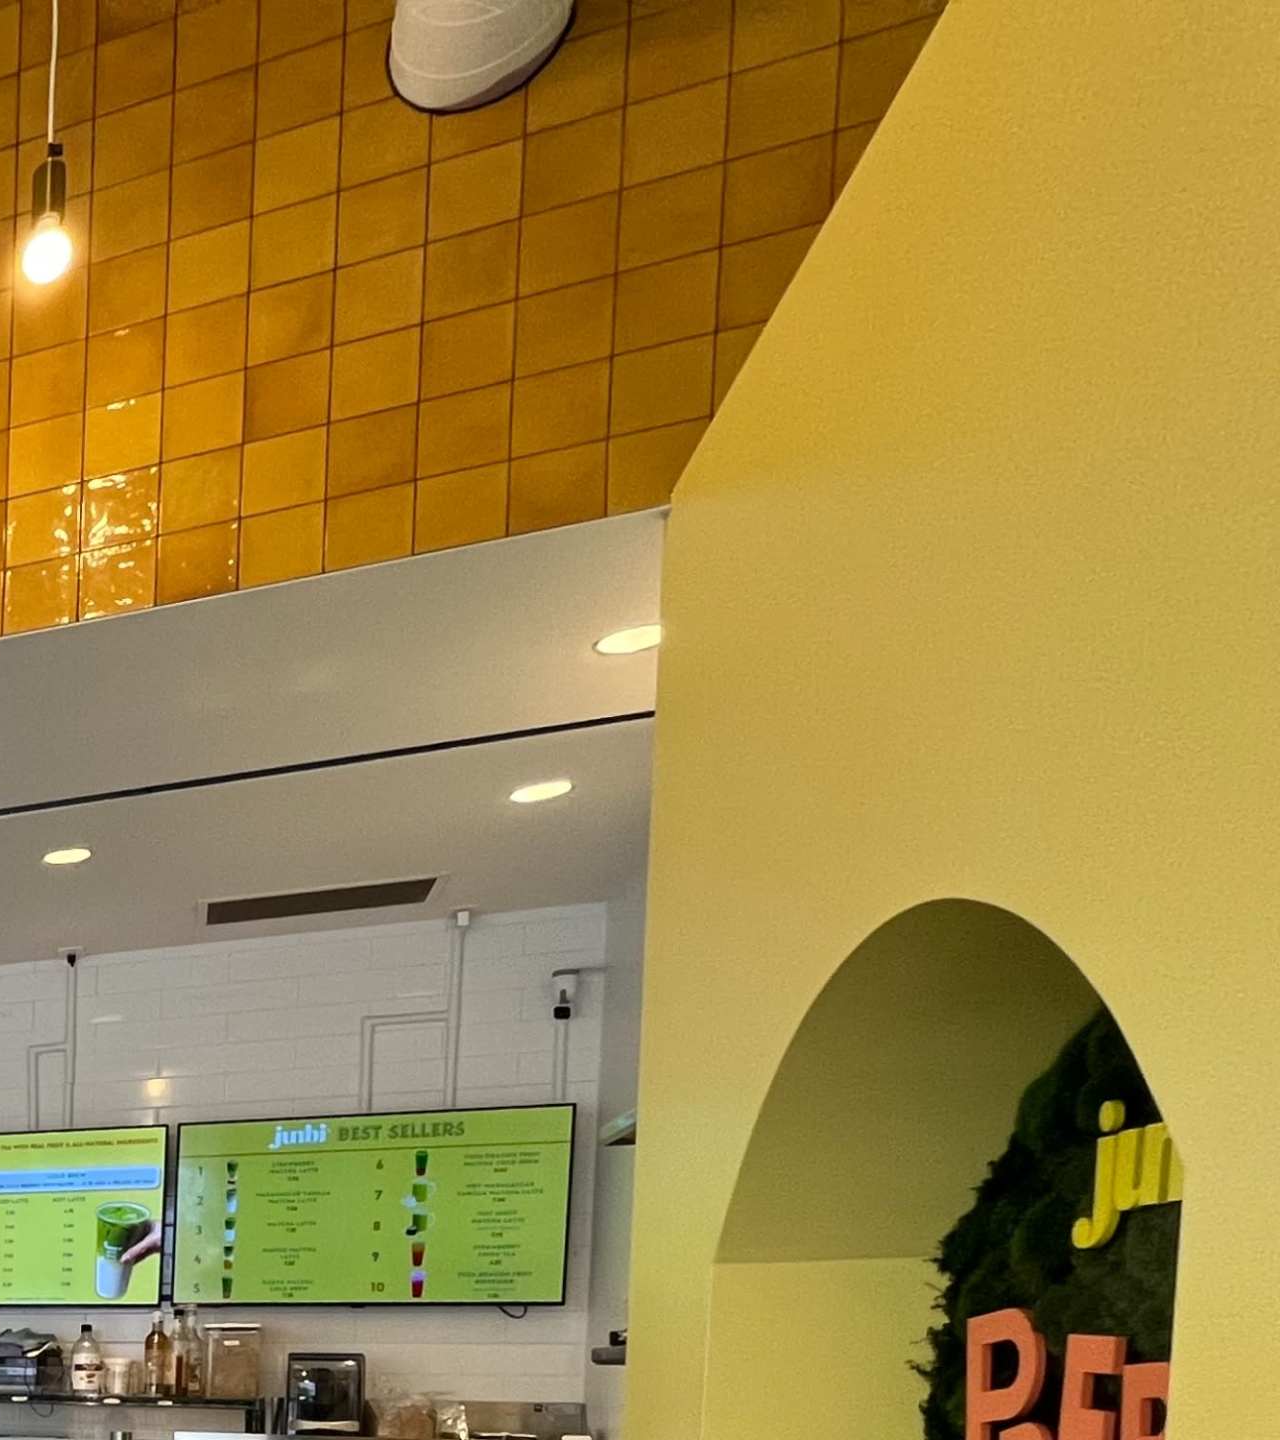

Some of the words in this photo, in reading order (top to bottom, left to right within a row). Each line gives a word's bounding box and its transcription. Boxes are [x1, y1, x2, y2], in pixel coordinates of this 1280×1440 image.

[267, 1123, 329, 1149] junbi
[338, 1124, 383, 1142] BEST
[387, 1121, 465, 1140] SELLERS
[375, 1159, 384, 1169] 6
[374, 1190, 383, 1200] 7
[373, 1221, 381, 1231] 8
[371, 1252, 380, 1262] 9
[193, 1283, 201, 1293] 5
[370, 1282, 385, 1293] 10
